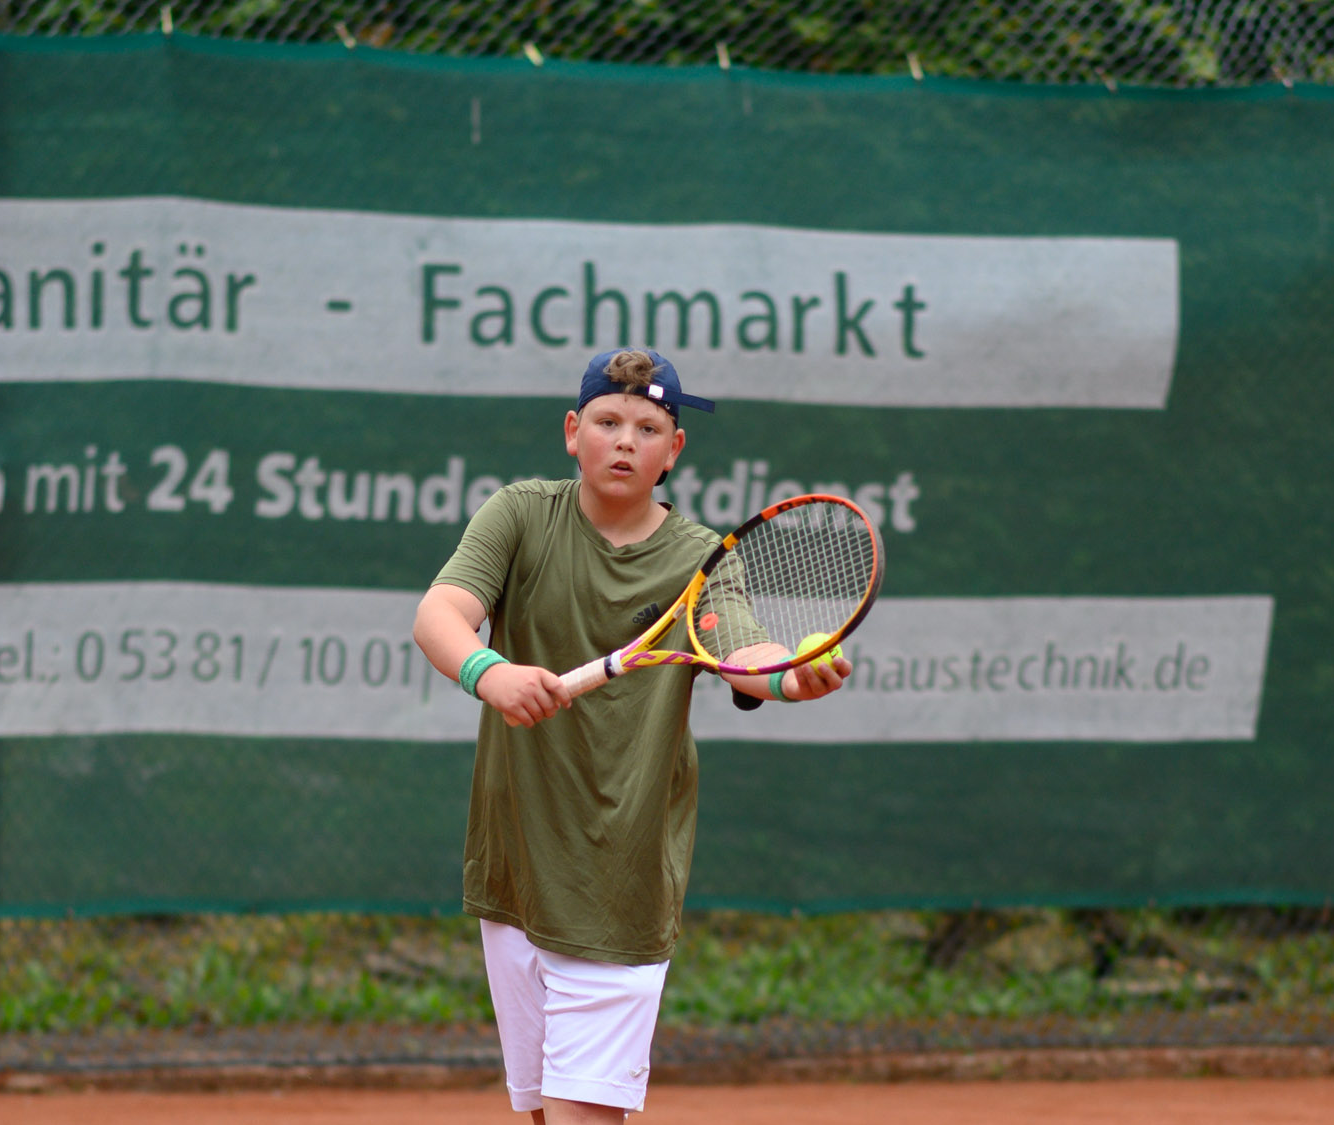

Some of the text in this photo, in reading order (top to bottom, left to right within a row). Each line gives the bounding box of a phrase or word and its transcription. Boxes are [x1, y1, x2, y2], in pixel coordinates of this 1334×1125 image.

[418, 260, 929, 358] Fachmarkt
[24, 445, 127, 514] mit
[146, 444, 234, 514] 24
[254, 450, 549, 525] Stunde
[845, 638, 1212, 694] haustechnik.de
